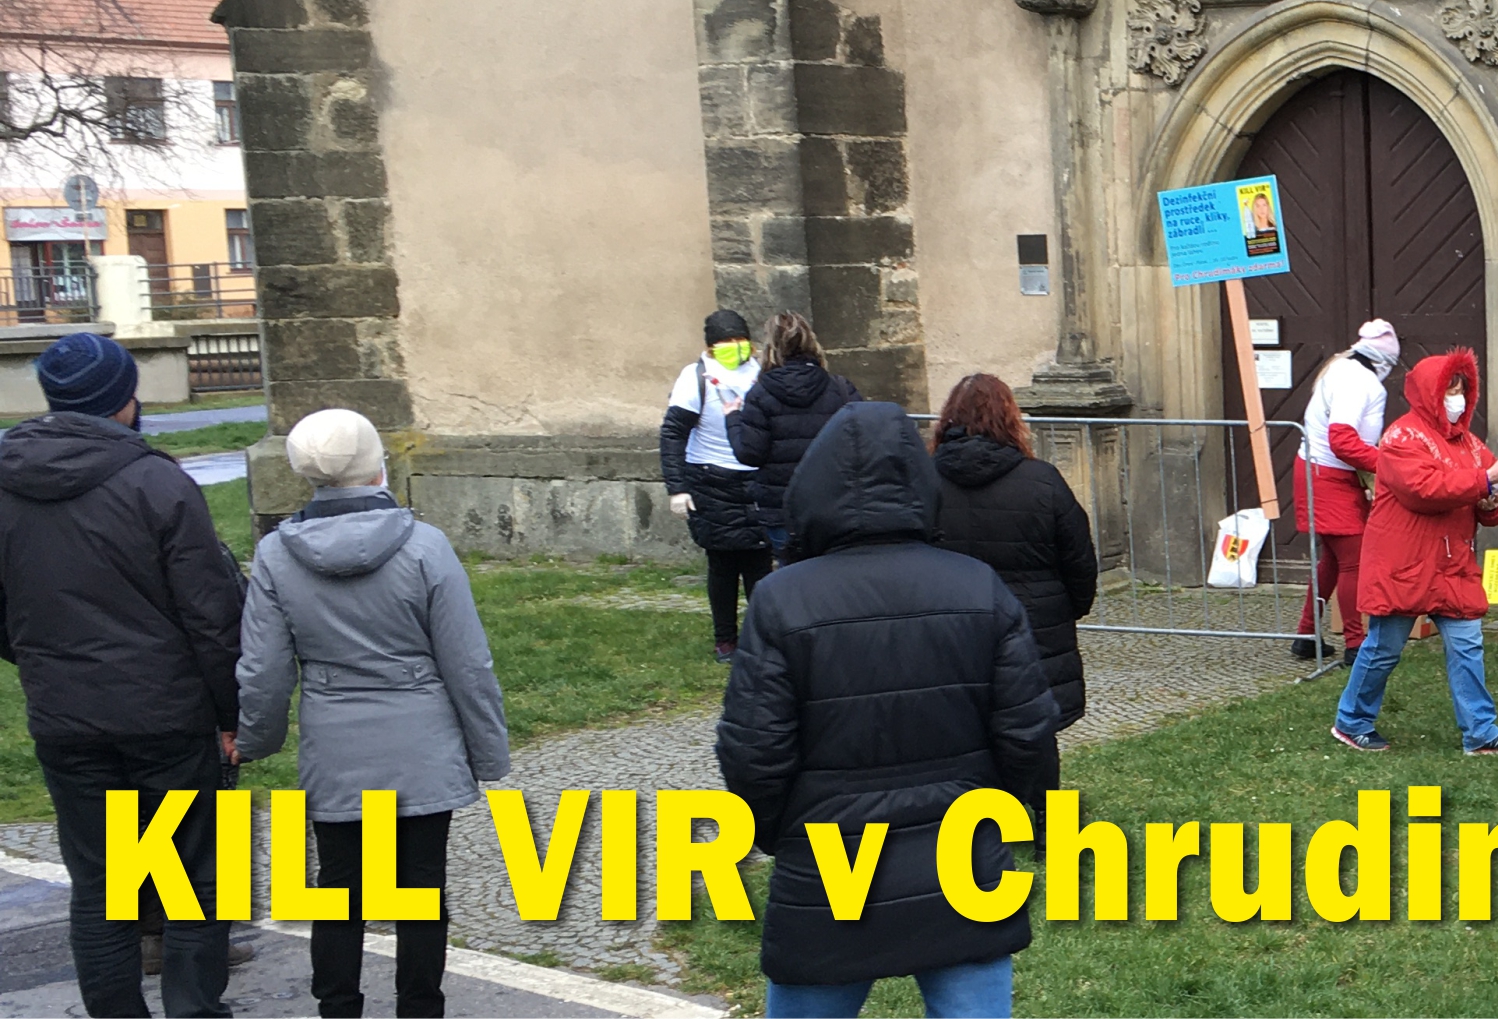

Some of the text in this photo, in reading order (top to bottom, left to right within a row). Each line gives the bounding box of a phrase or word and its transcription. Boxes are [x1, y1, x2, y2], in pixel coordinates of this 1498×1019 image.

[1162, 189, 1217, 207] Dezinfekční
[1239, 187, 1254, 195] KILL
[1164, 202, 1216, 219] prostředek
[1166, 211, 1230, 228] na ruce, kliky,
[1174, 271, 1191, 282] Pro
[1193, 265, 1247, 280] Chrudimáky
